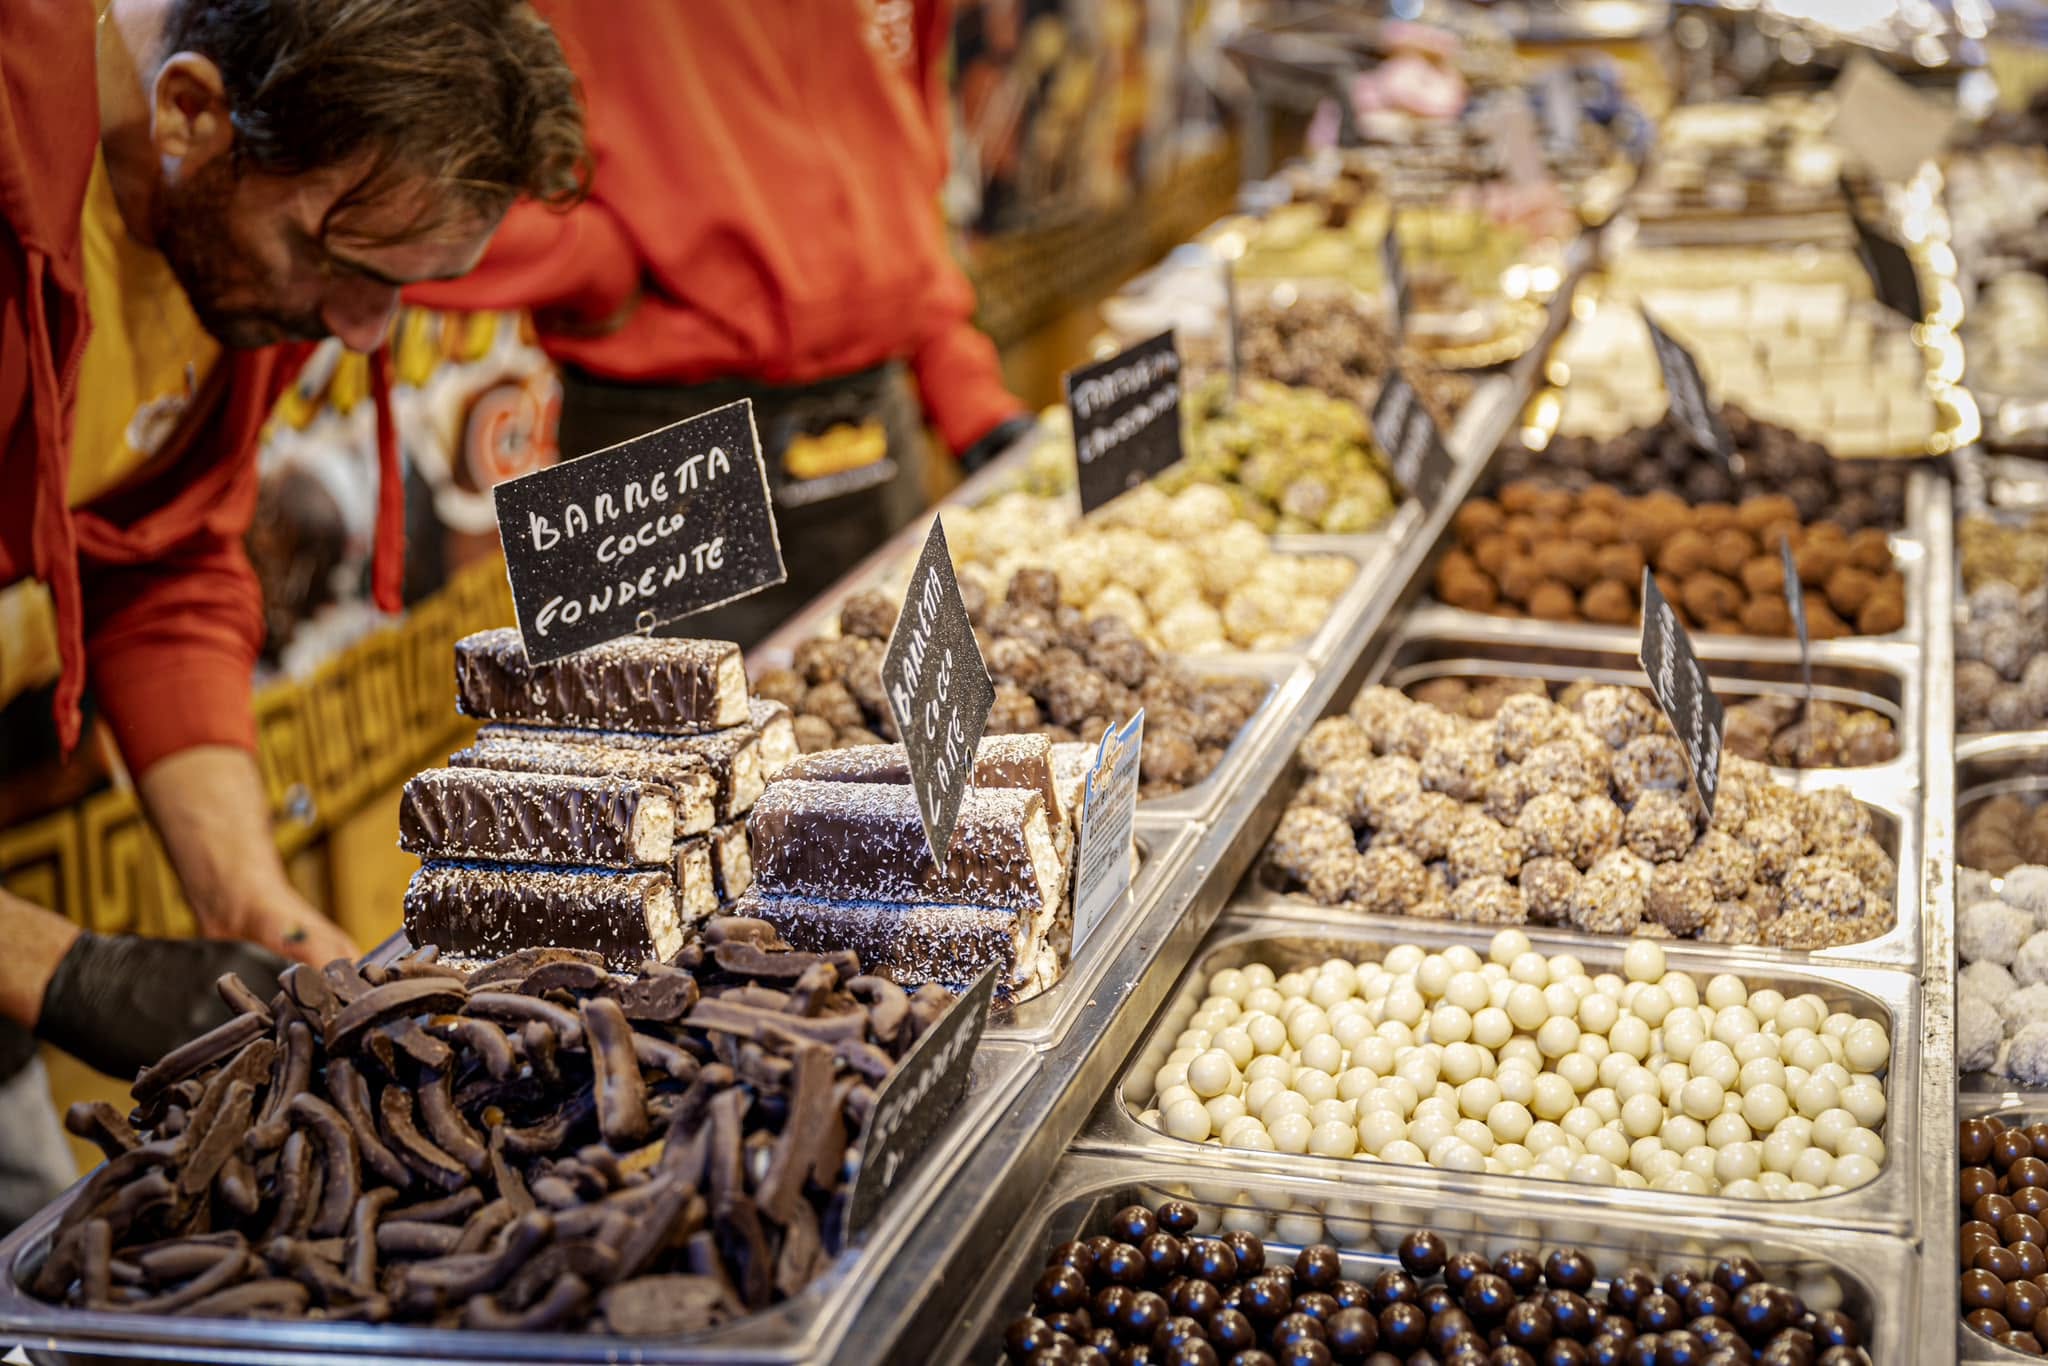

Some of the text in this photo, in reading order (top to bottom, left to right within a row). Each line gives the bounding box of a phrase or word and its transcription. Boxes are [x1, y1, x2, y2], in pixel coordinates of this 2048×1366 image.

[529, 446, 730, 552] BARRETTA
[597, 513, 685, 563] COCCO
[535, 537, 723, 636] FONDENTE
[892, 566, 944, 727] BARRETTA
[925, 649, 952, 741] COCCO
[928, 705, 965, 826] LATTE
